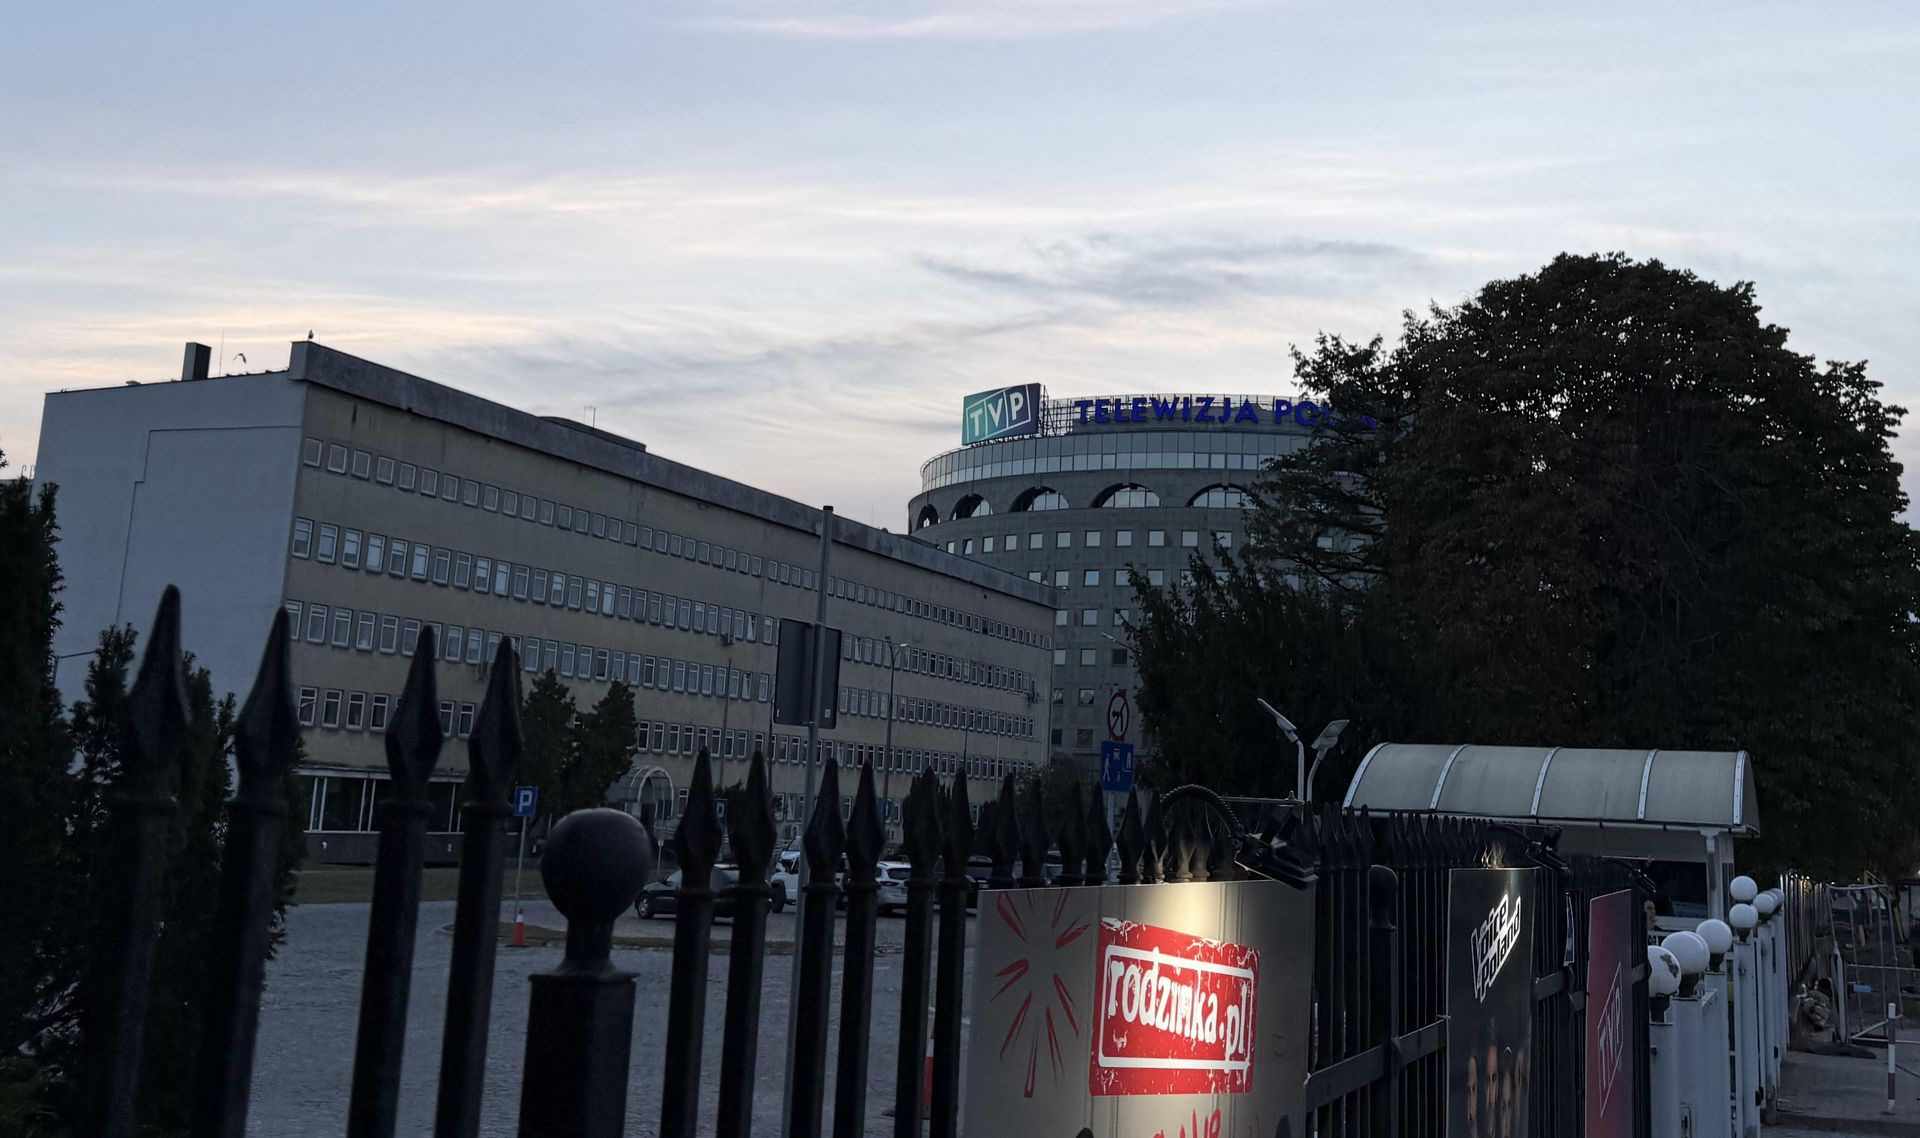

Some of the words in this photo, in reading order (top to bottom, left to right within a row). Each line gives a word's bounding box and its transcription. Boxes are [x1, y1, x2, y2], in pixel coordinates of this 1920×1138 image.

[969, 391, 1024, 437] TVP
[1074, 396, 1259, 425] TELEWIZJA
[518, 790, 533, 813] P
[1108, 946, 1247, 1073] rodzinka.pl
